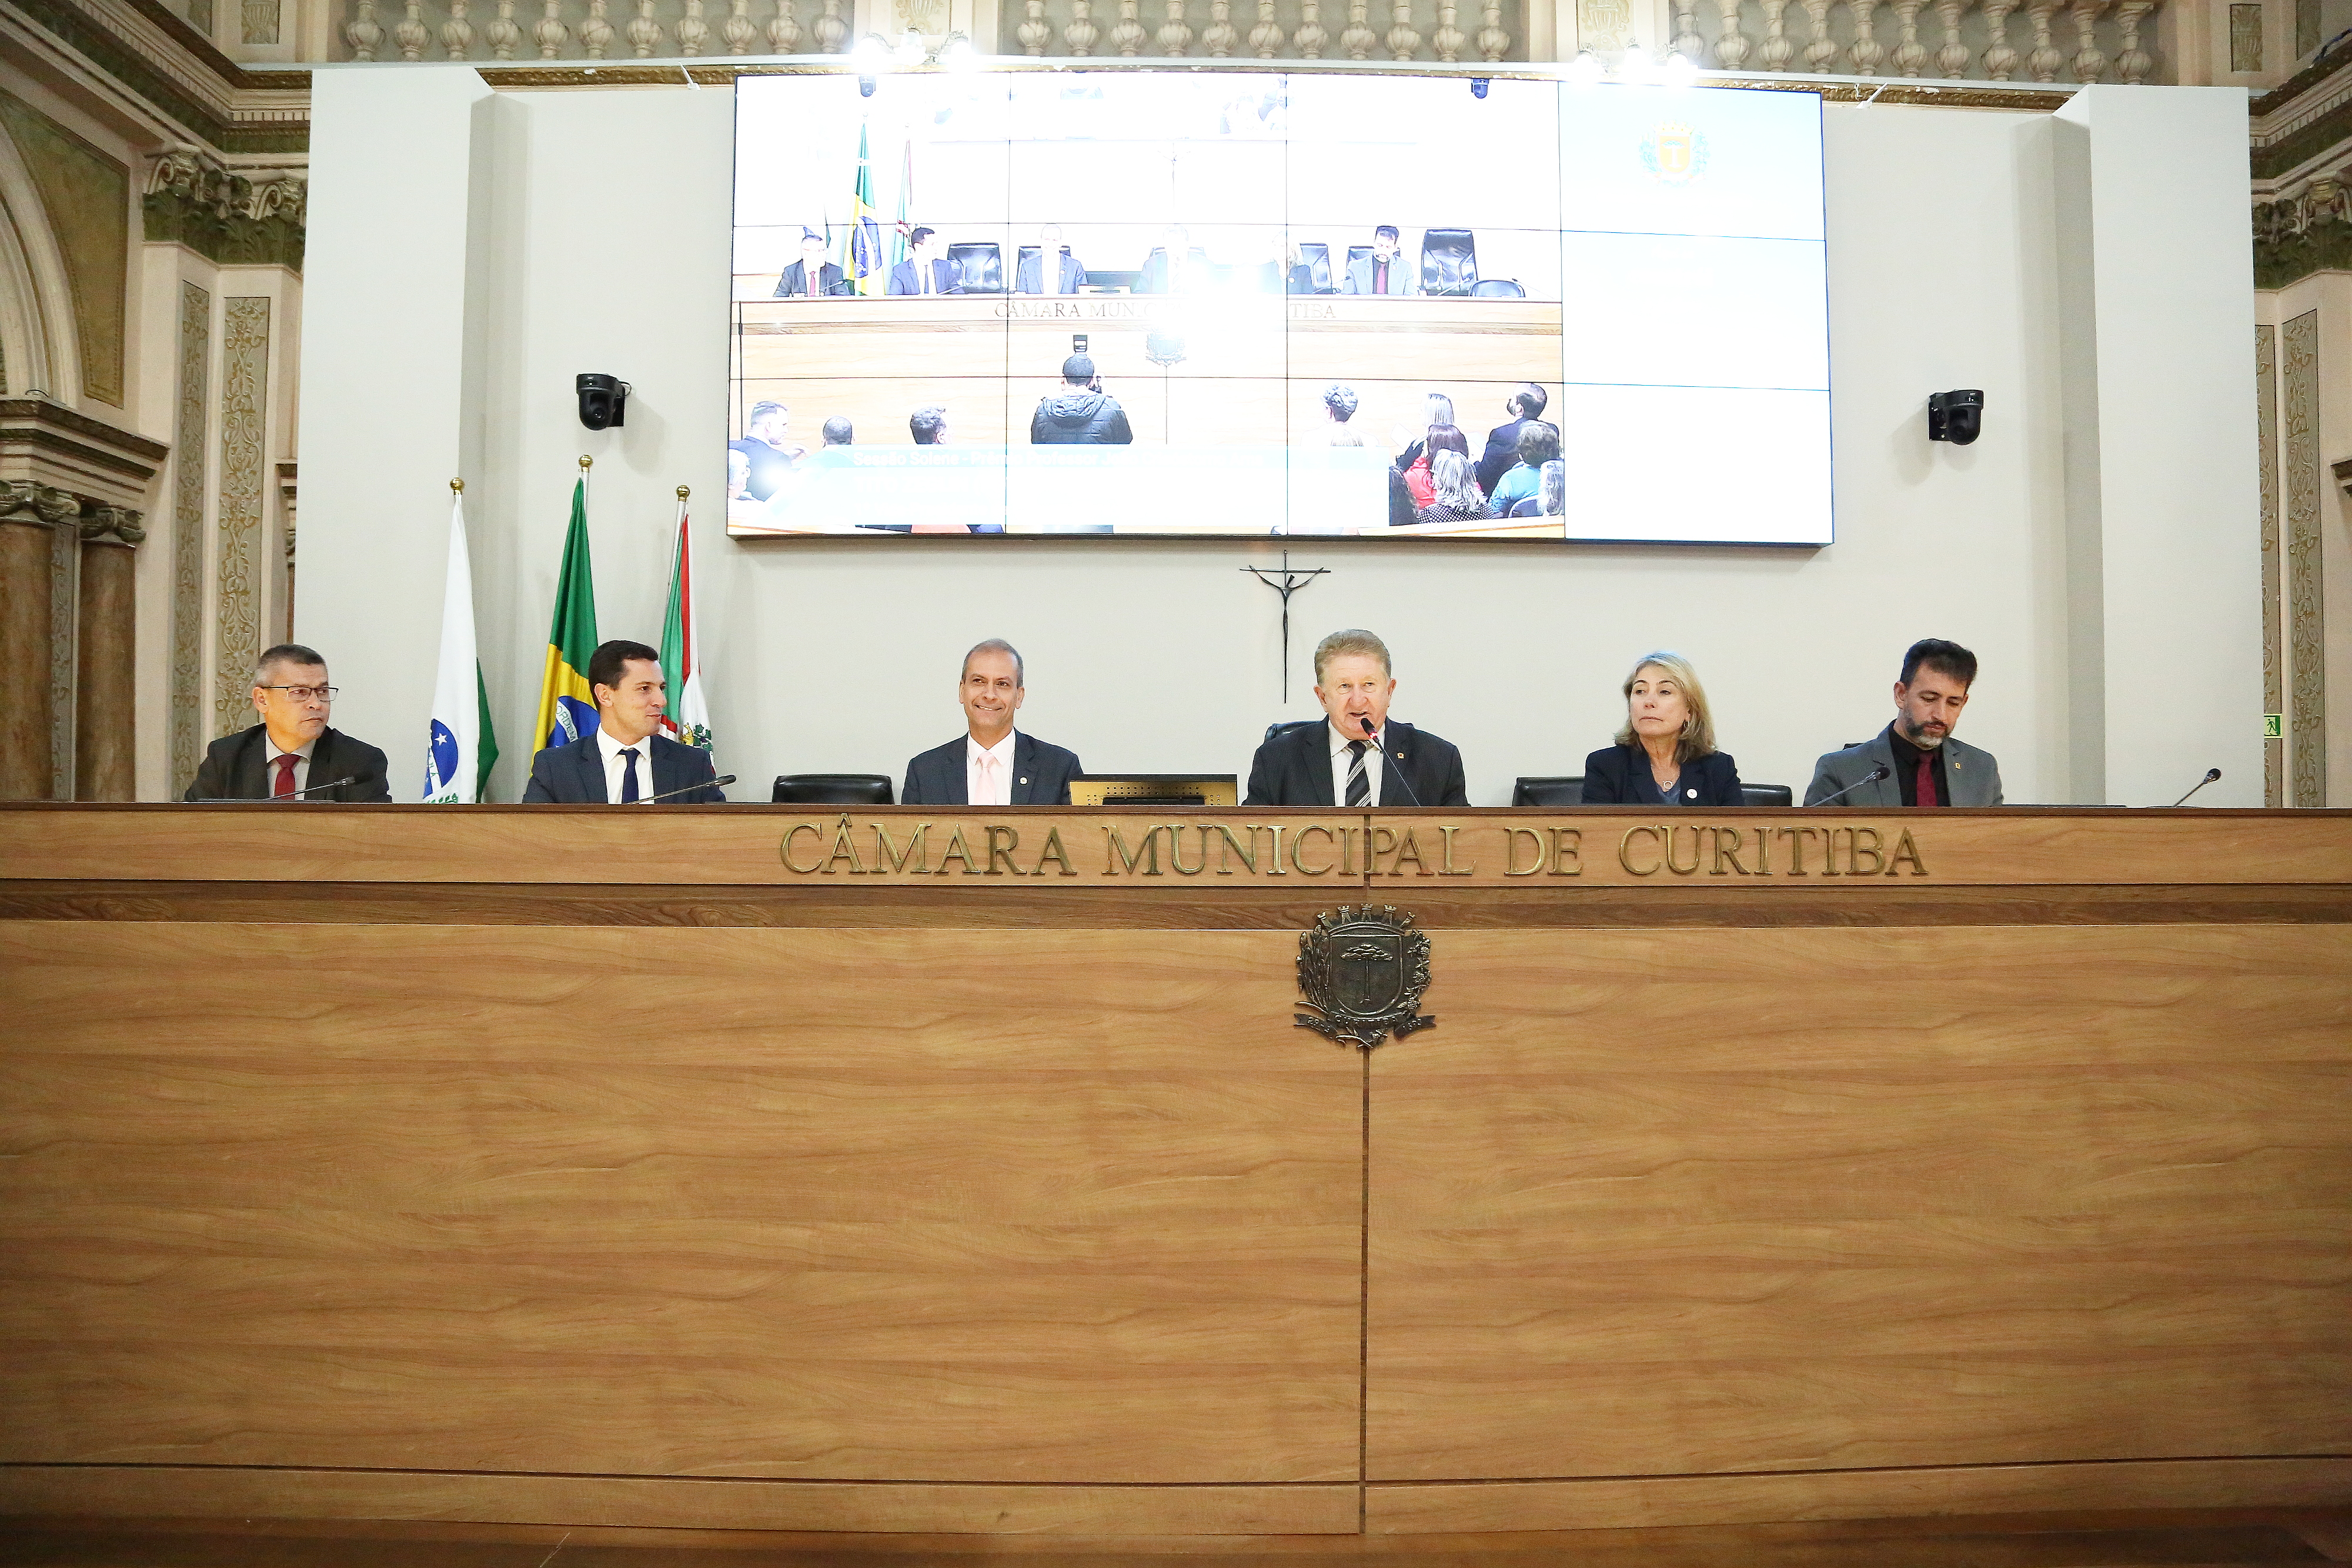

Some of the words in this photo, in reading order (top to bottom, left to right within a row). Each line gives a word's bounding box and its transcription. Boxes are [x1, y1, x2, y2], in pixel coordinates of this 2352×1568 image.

[780, 813, 1078, 875] CÂMARA
[1101, 824, 1476, 876] MUNICIPAL
[1504, 825, 1583, 876] DE
[1619, 824, 1930, 876] CURITIBA
